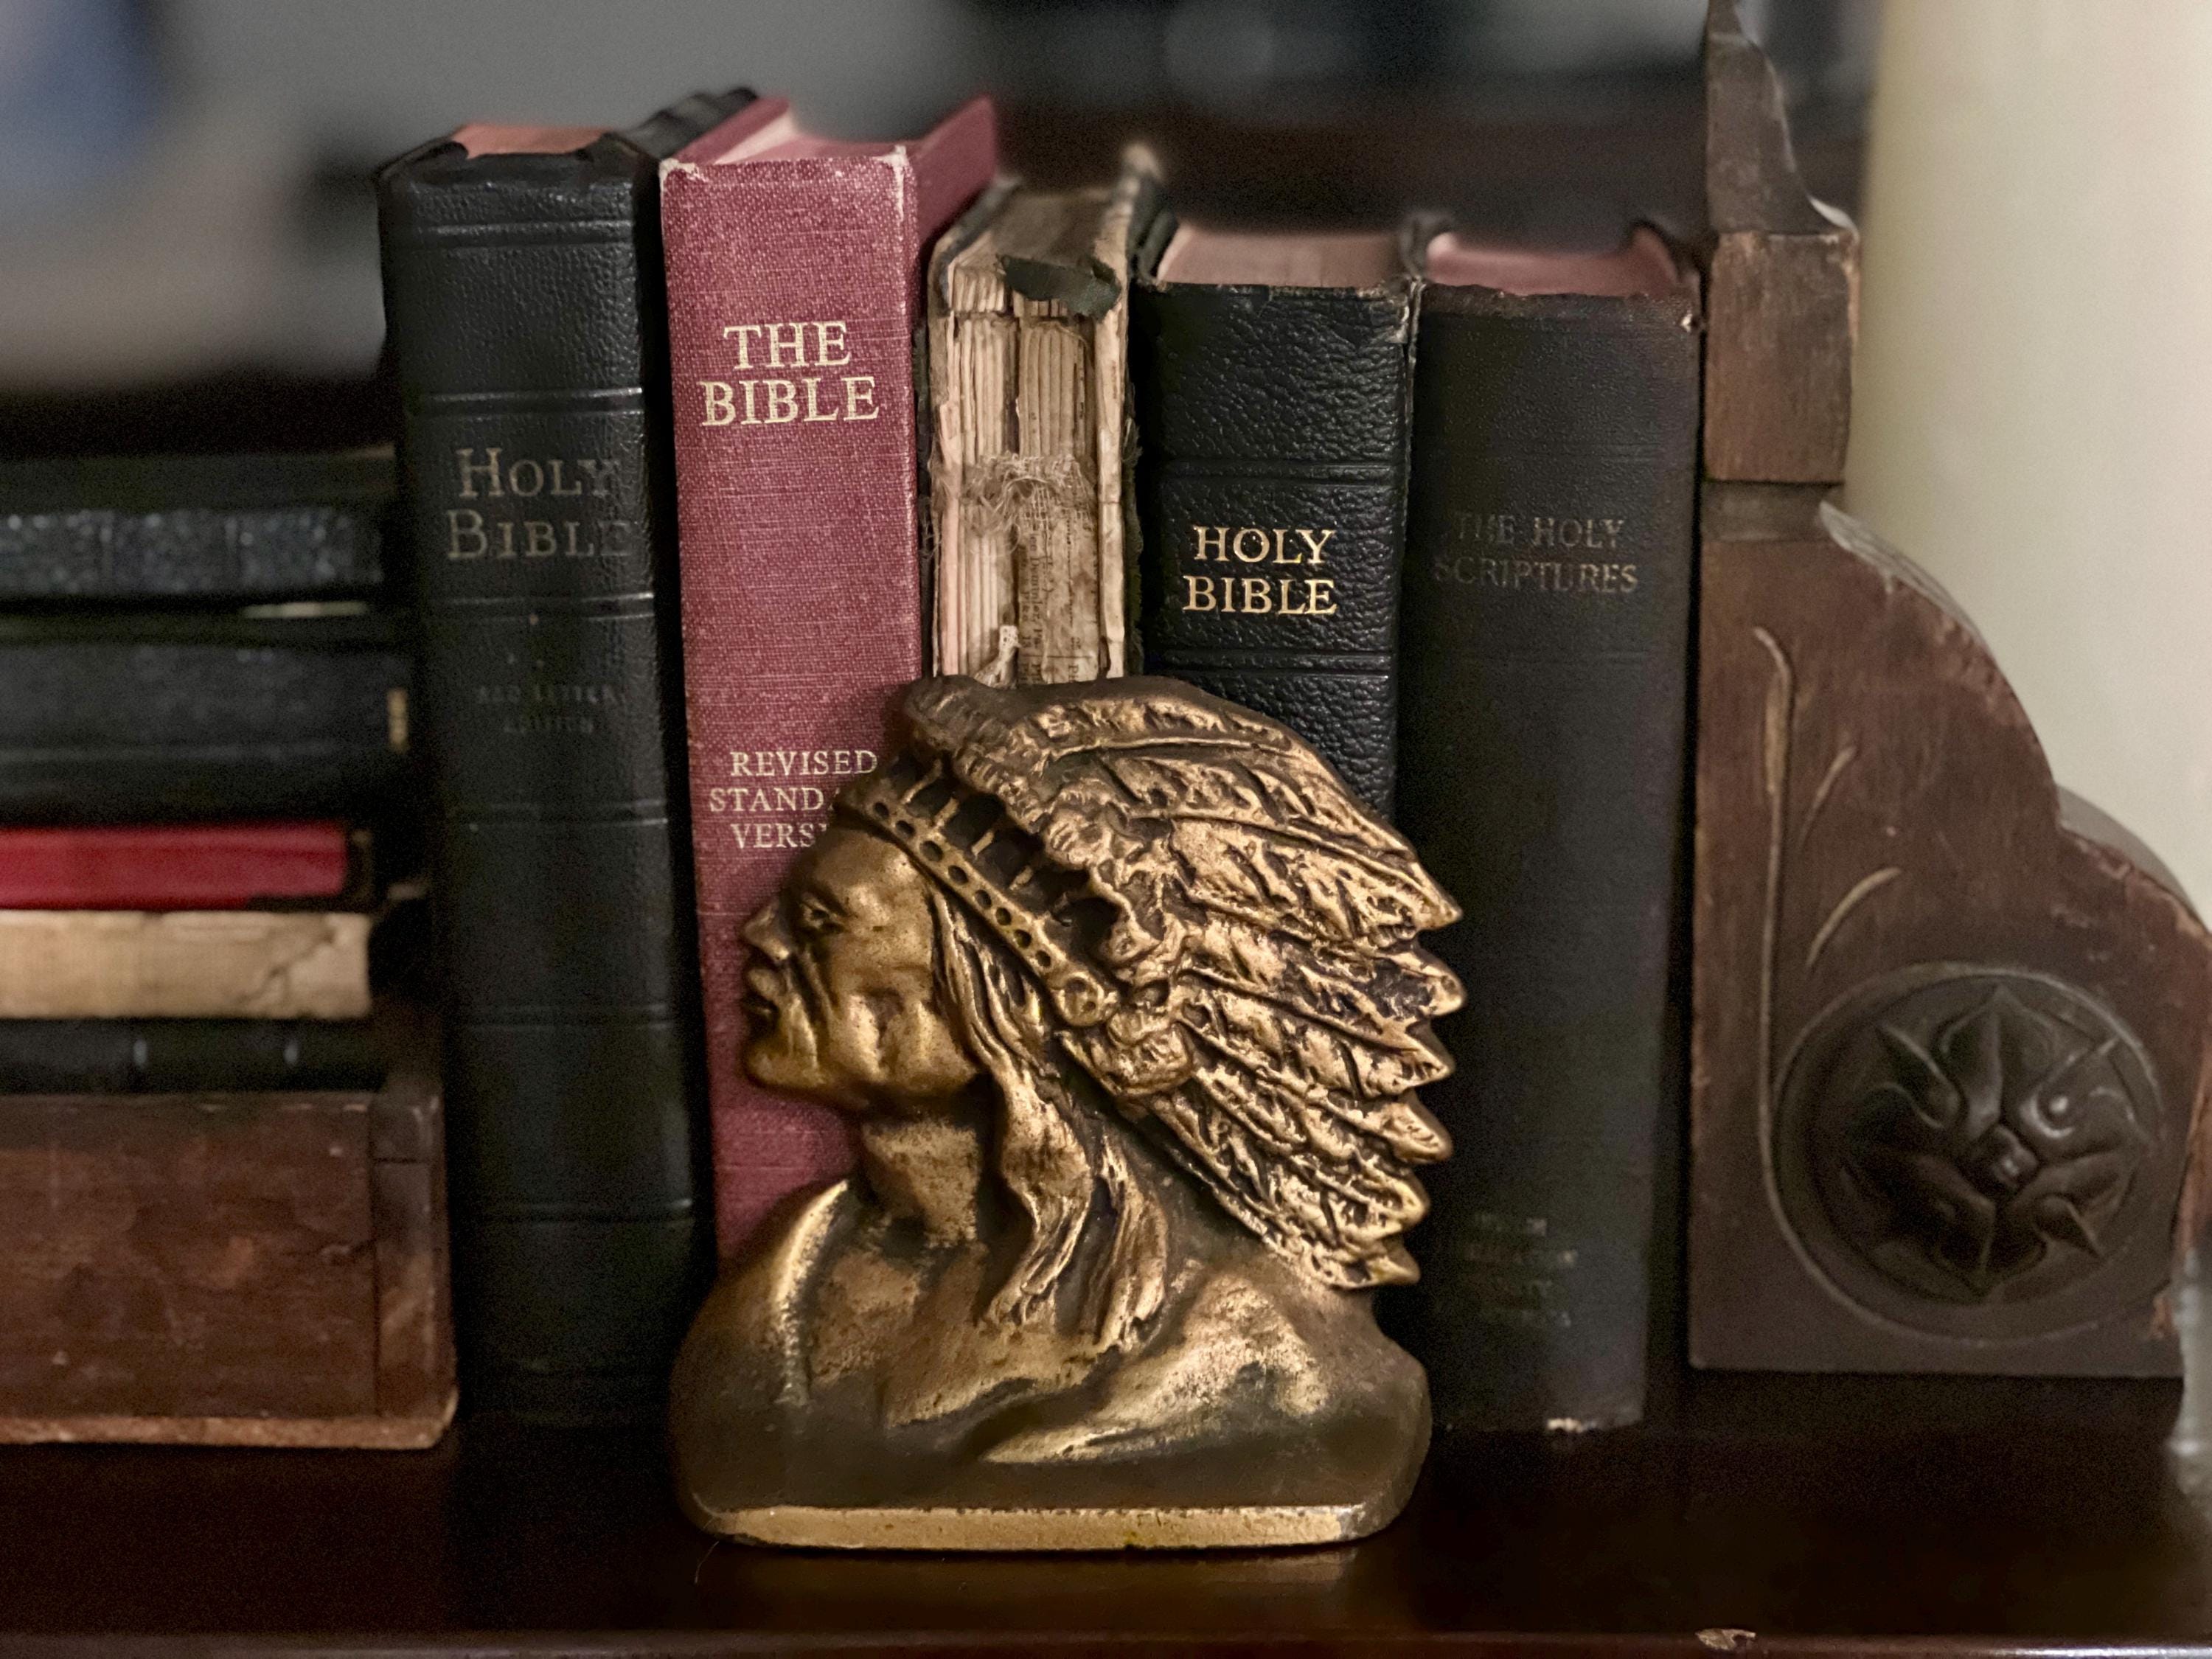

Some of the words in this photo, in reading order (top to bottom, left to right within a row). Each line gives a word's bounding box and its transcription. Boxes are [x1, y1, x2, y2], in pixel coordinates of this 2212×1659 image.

[722, 320, 852, 372] THE
[696, 375, 880, 426] BIBLE
[455, 447, 622, 499] HOLY
[445, 508, 633, 560] BIBLE
[1192, 525, 1337, 565] HOLY
[1531, 516, 1625, 549] HOLY
[1182, 574, 1338, 615] BIBLE
[729, 749, 878, 776] REVISED
[709, 786, 841, 813] STAND
[730, 823, 827, 850] VERS
